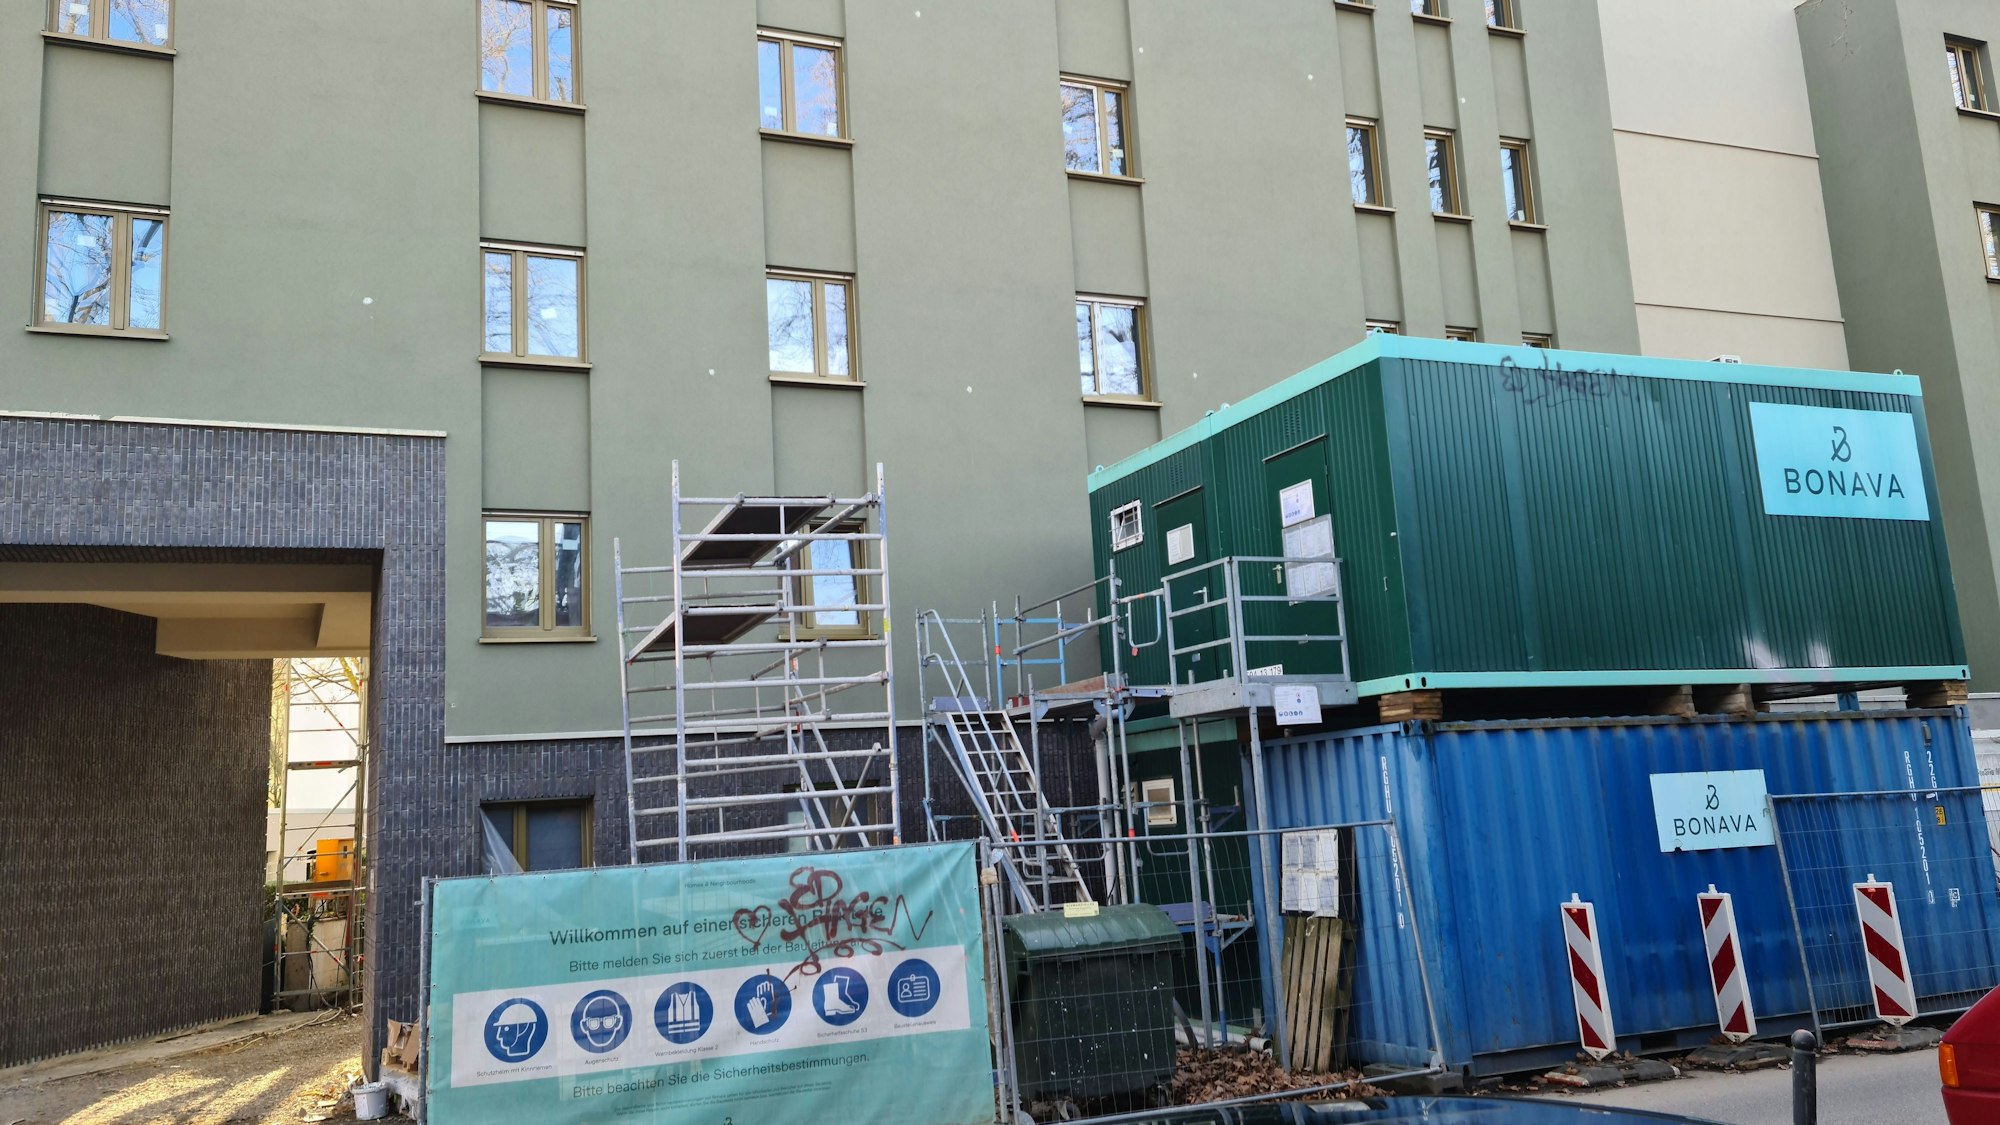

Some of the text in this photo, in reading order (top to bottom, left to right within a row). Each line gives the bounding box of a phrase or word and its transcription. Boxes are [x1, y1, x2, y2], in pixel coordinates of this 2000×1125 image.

[1784, 467, 1905, 499] BONAVA
[1381, 756, 1393, 814] RGHU
[1673, 814, 1757, 836] BONAVA
[1914, 807, 1931, 885] 105201
[550, 926, 657, 946] Willkommen
[663, 919, 689, 936] auf
[693, 917, 734, 933] einer
[738, 910, 807, 928] sicheren
[569, 959, 599, 972] Bitte
[602, 955, 649, 969] melden
[652, 953, 671, 965] Sie
[675, 950, 698, 962] sich
[702, 948, 738, 961] zuerst
[741, 944, 759, 957] bei
[761, 941, 781, 956] der
[573, 1054, 870, 1098] Bitte beachten Sie die Sicherheitsbestimmungen.
